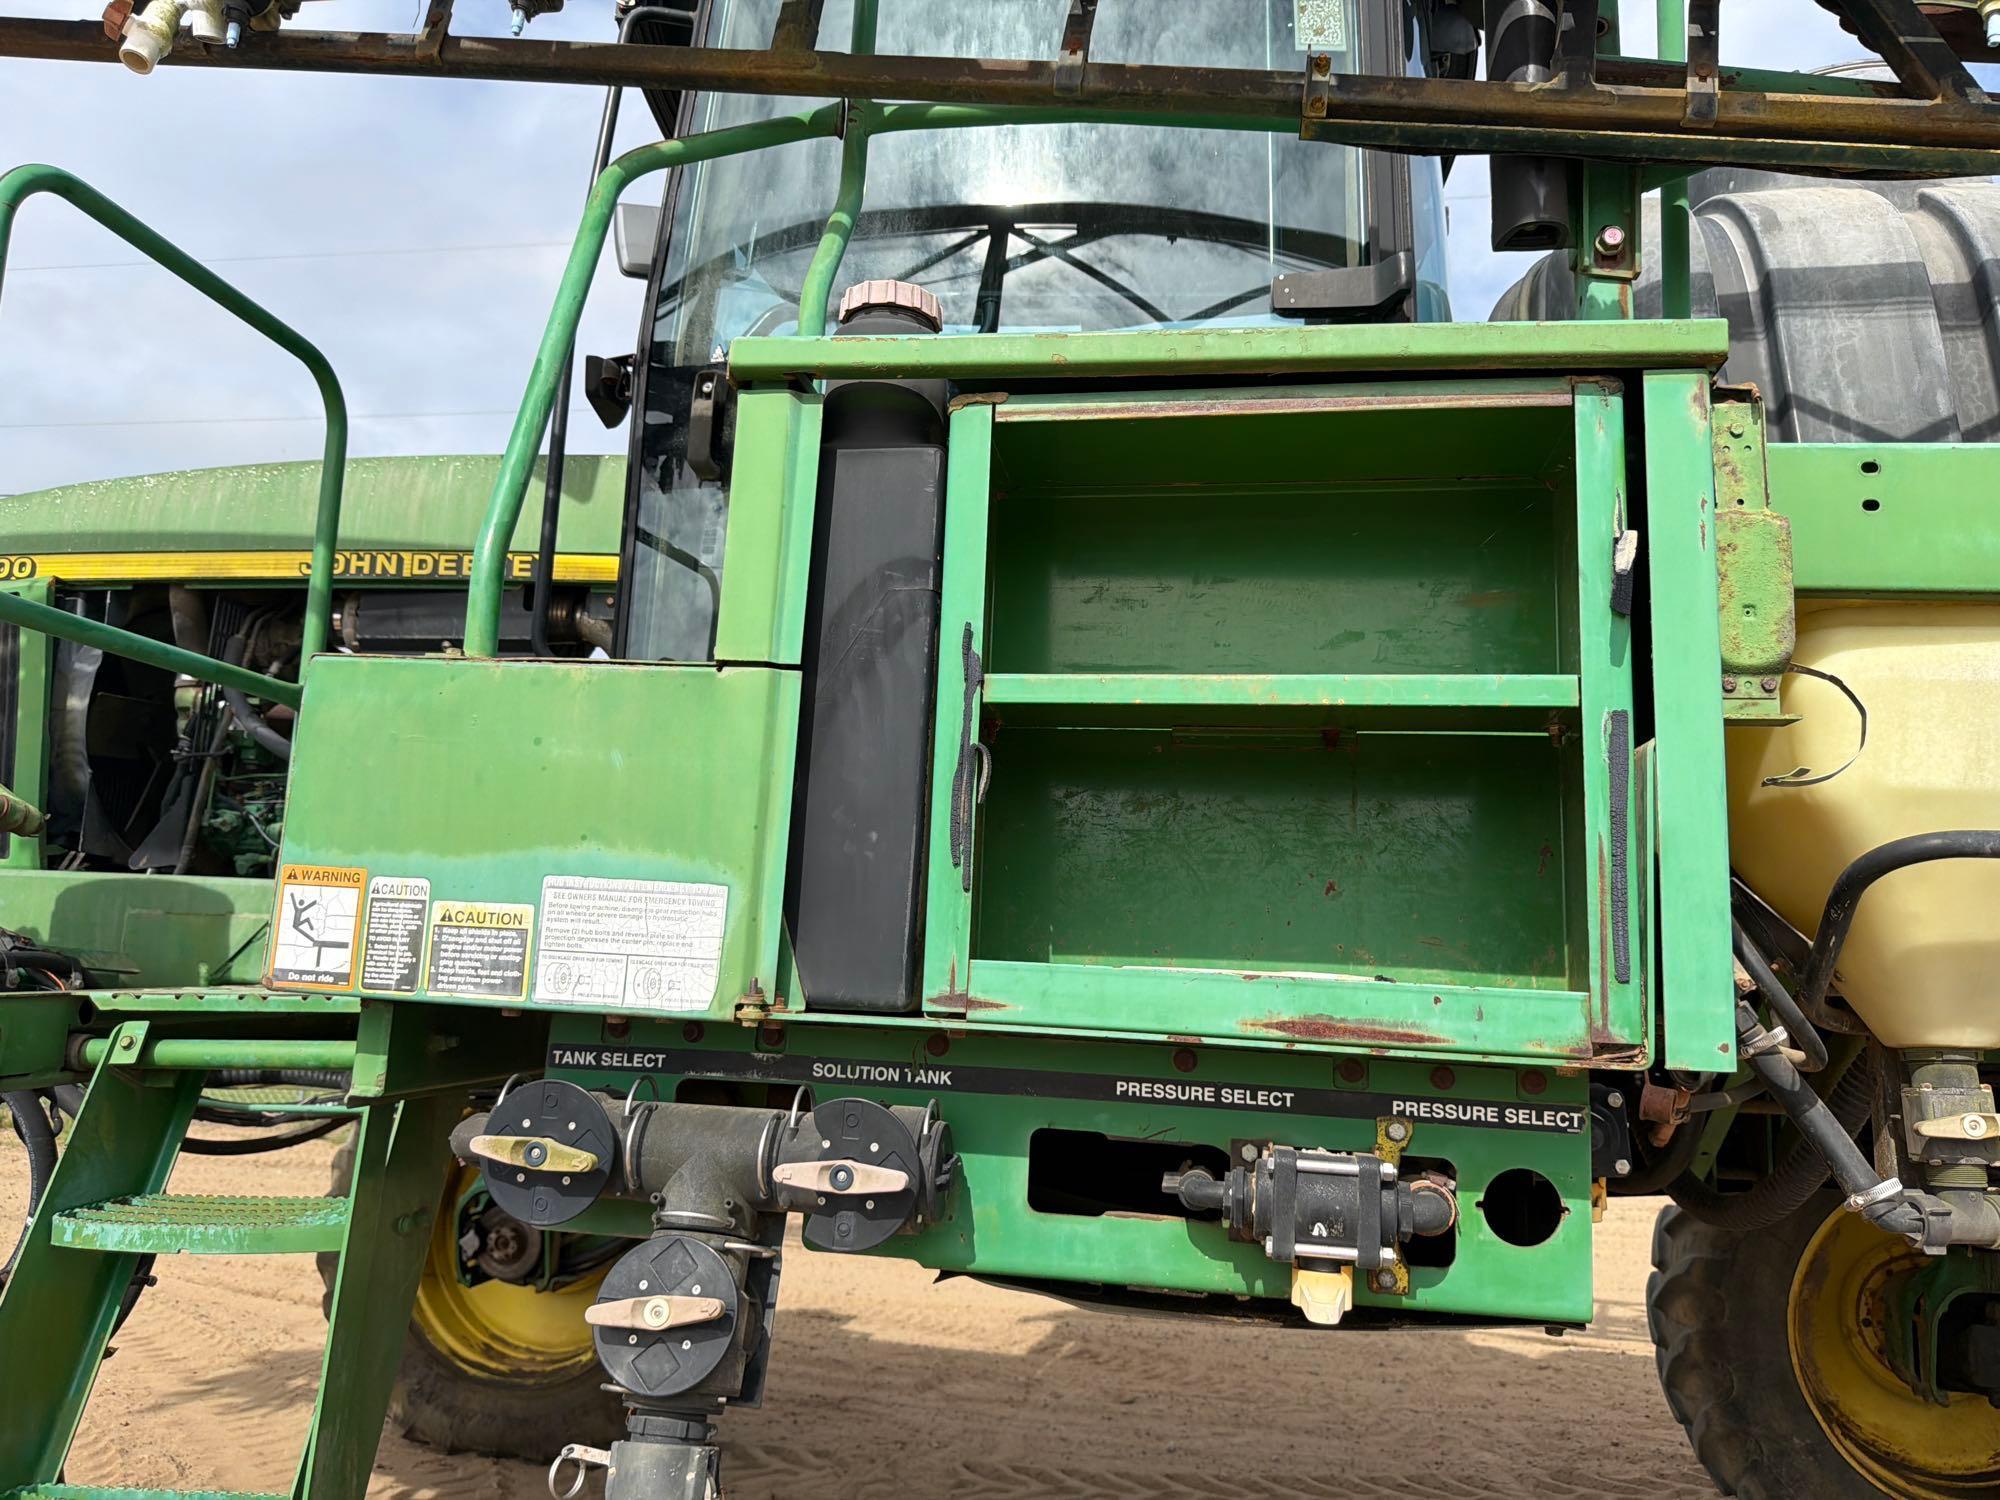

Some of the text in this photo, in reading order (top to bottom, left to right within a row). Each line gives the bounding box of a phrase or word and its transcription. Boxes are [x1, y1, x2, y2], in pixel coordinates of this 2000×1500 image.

[411, 554, 533, 577] DEEE
[302, 870, 360, 882] WARNING
[382, 884, 427, 896] CAUTION
[553, 891, 566, 900] SEE
[568, 892, 596, 901] OWNERS
[598, 894, 626, 902] MANUAL
[629, 896, 643, 904] FOR
[645, 897, 686, 905] EMERGENCY
[455, 910, 523, 925] CAUTION
[288, 972, 300, 980] Do
[553, 1050, 666, 1068] TANK SELECT
[812, 1062, 952, 1086] SOLUTION TANK
[1116, 1081, 1294, 1107] PRESSURE SELECT
[1392, 1101, 1581, 1128] PRESSURE SELECT
